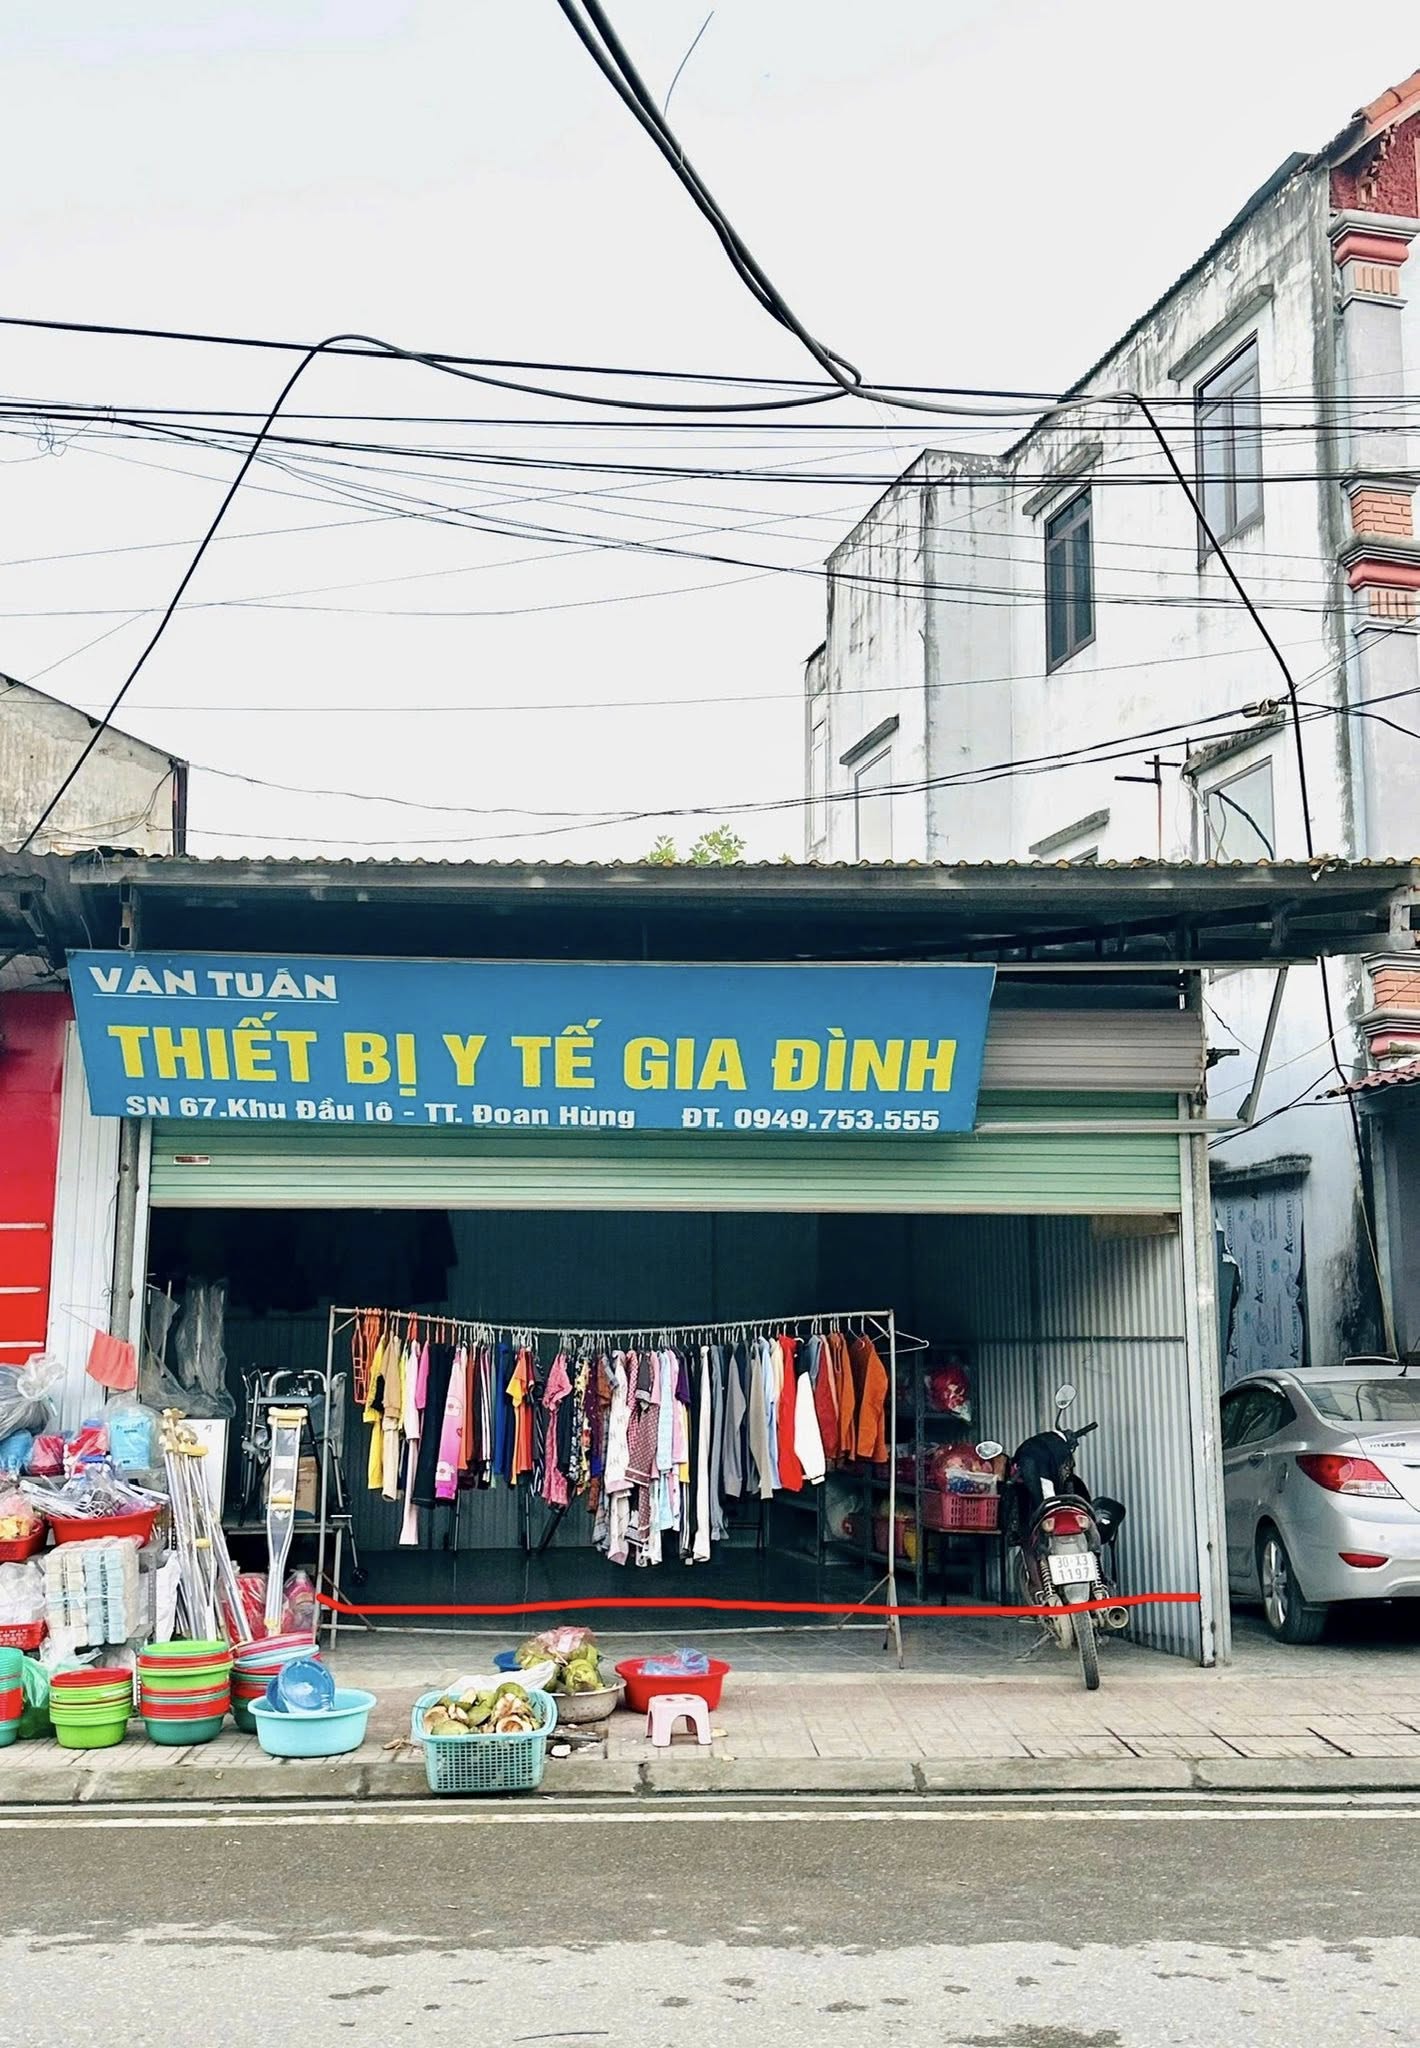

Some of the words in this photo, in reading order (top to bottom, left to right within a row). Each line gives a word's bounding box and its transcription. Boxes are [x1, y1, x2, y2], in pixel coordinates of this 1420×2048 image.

[88, 965, 198, 996] VÂN
[107, 1010, 318, 1083] THIẾT
[343, 1032, 418, 1098] BỊ
[442, 1034, 487, 1087] Y
[511, 1018, 603, 1089] TẾ
[623, 1036, 748, 1091] GIA
[771, 1027, 958, 1093] ĐÌNH
[125, 1095, 170, 1116] SN
[180, 1097, 287, 1119] 67.Khu
[295, 1096, 355, 1121] Đầu
[365, 1099, 394, 1122] lô
[424, 1102, 463, 1123] TT.
[472, 1103, 549, 1126] Đoan
[559, 1104, 636, 1129] Hùng
[682, 1107, 724, 1129] ĐT.
[734, 1108, 940, 1131] 0949.753.555
[1059, 1567, 1089, 1580] 1197
